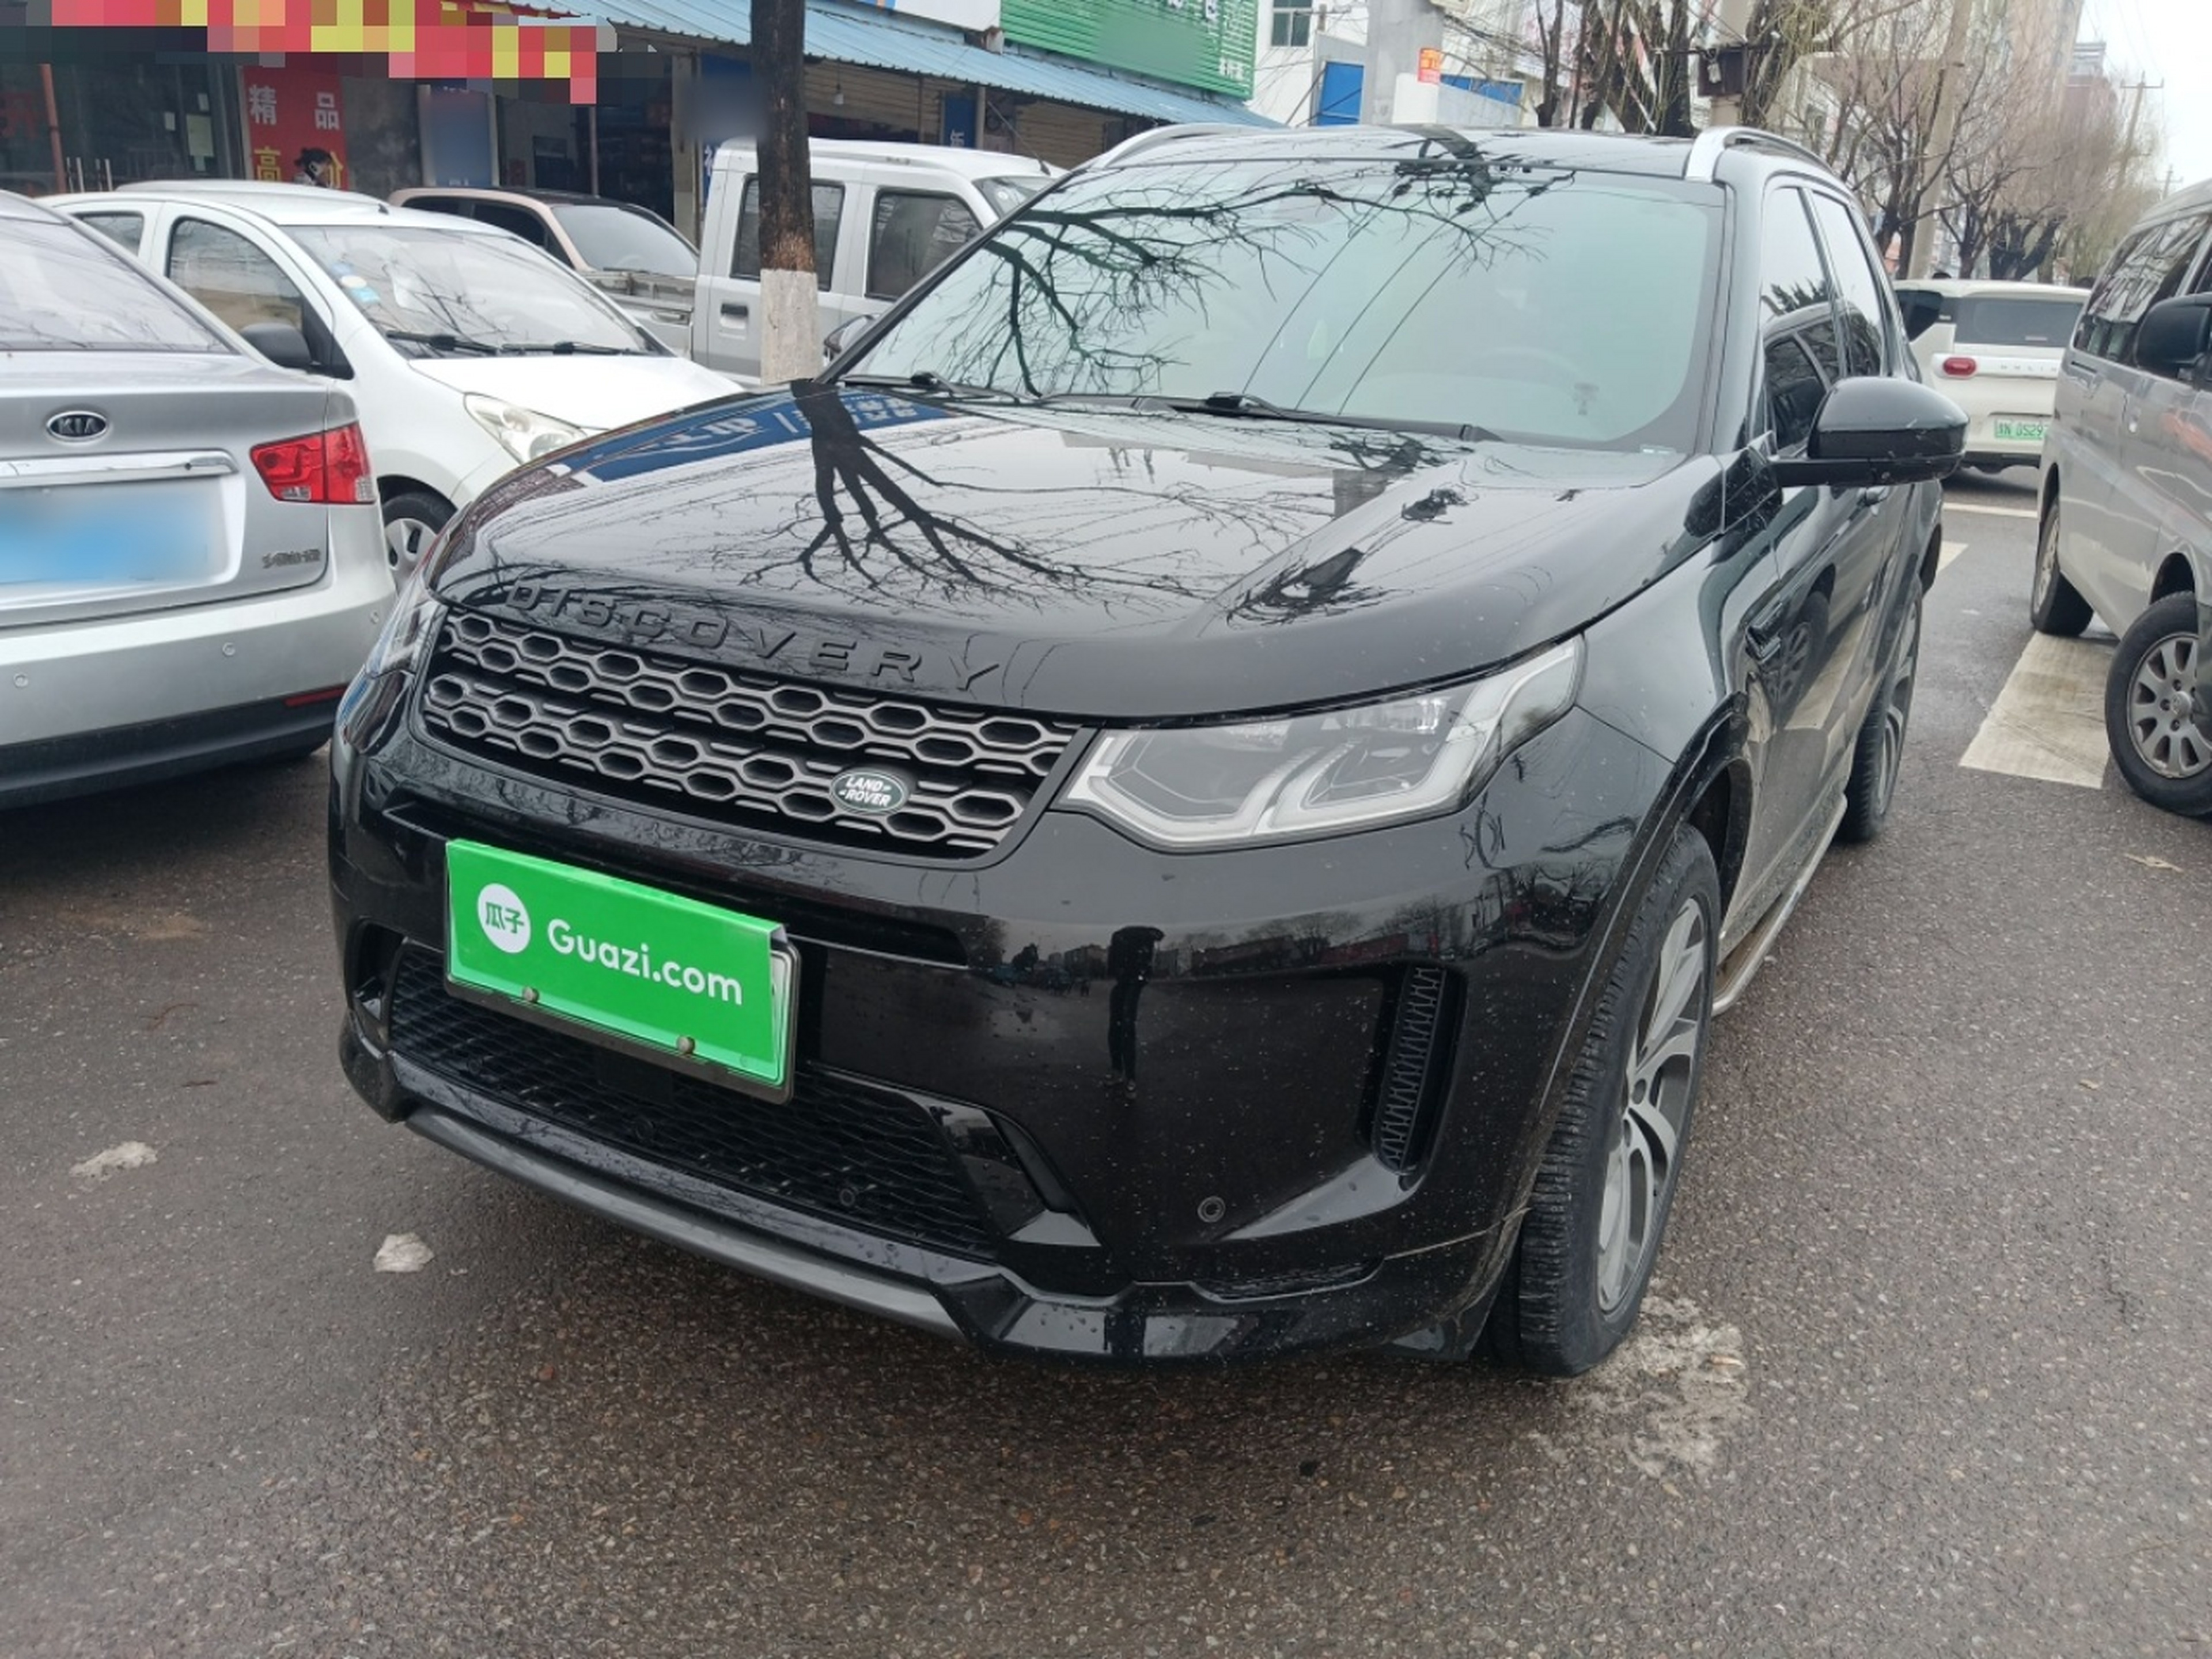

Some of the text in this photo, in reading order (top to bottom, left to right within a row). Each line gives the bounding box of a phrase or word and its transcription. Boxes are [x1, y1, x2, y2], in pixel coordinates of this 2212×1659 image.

[58, 418, 99, 434] KIA
[505, 581, 999, 691] DISCOVERY
[846, 777, 883, 791] LAND
[844, 789, 891, 806] ROVER
[486, 902, 524, 934] 瓜子
[548, 919, 742, 1005] Guazi.com
